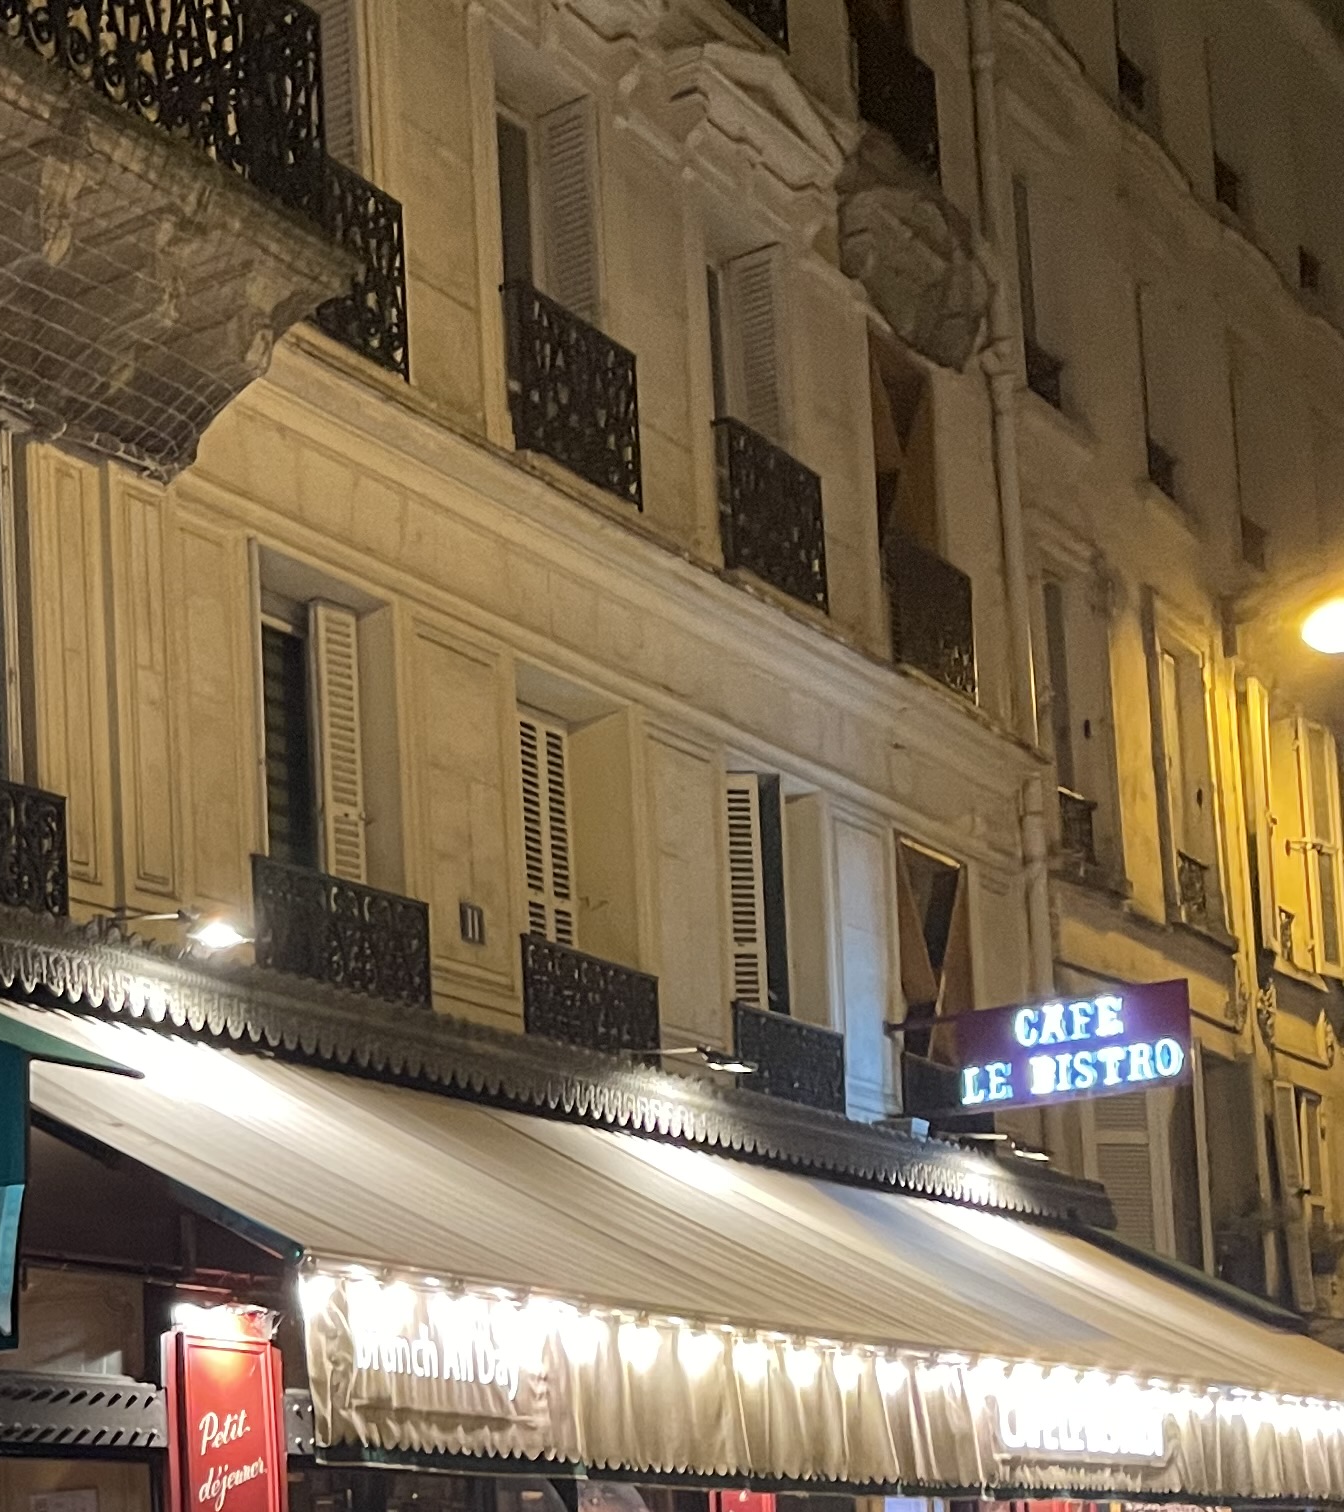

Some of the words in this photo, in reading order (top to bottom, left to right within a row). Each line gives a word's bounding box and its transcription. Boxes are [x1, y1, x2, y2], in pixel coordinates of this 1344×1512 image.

[1014, 996, 1125, 1047] CAFE
[962, 1061, 1013, 1105] LE
[1029, 1037, 1185, 1095] BISTRO
[199, 1410, 251, 1455] Petit
[199, 1457, 268, 1512] déjeuner
